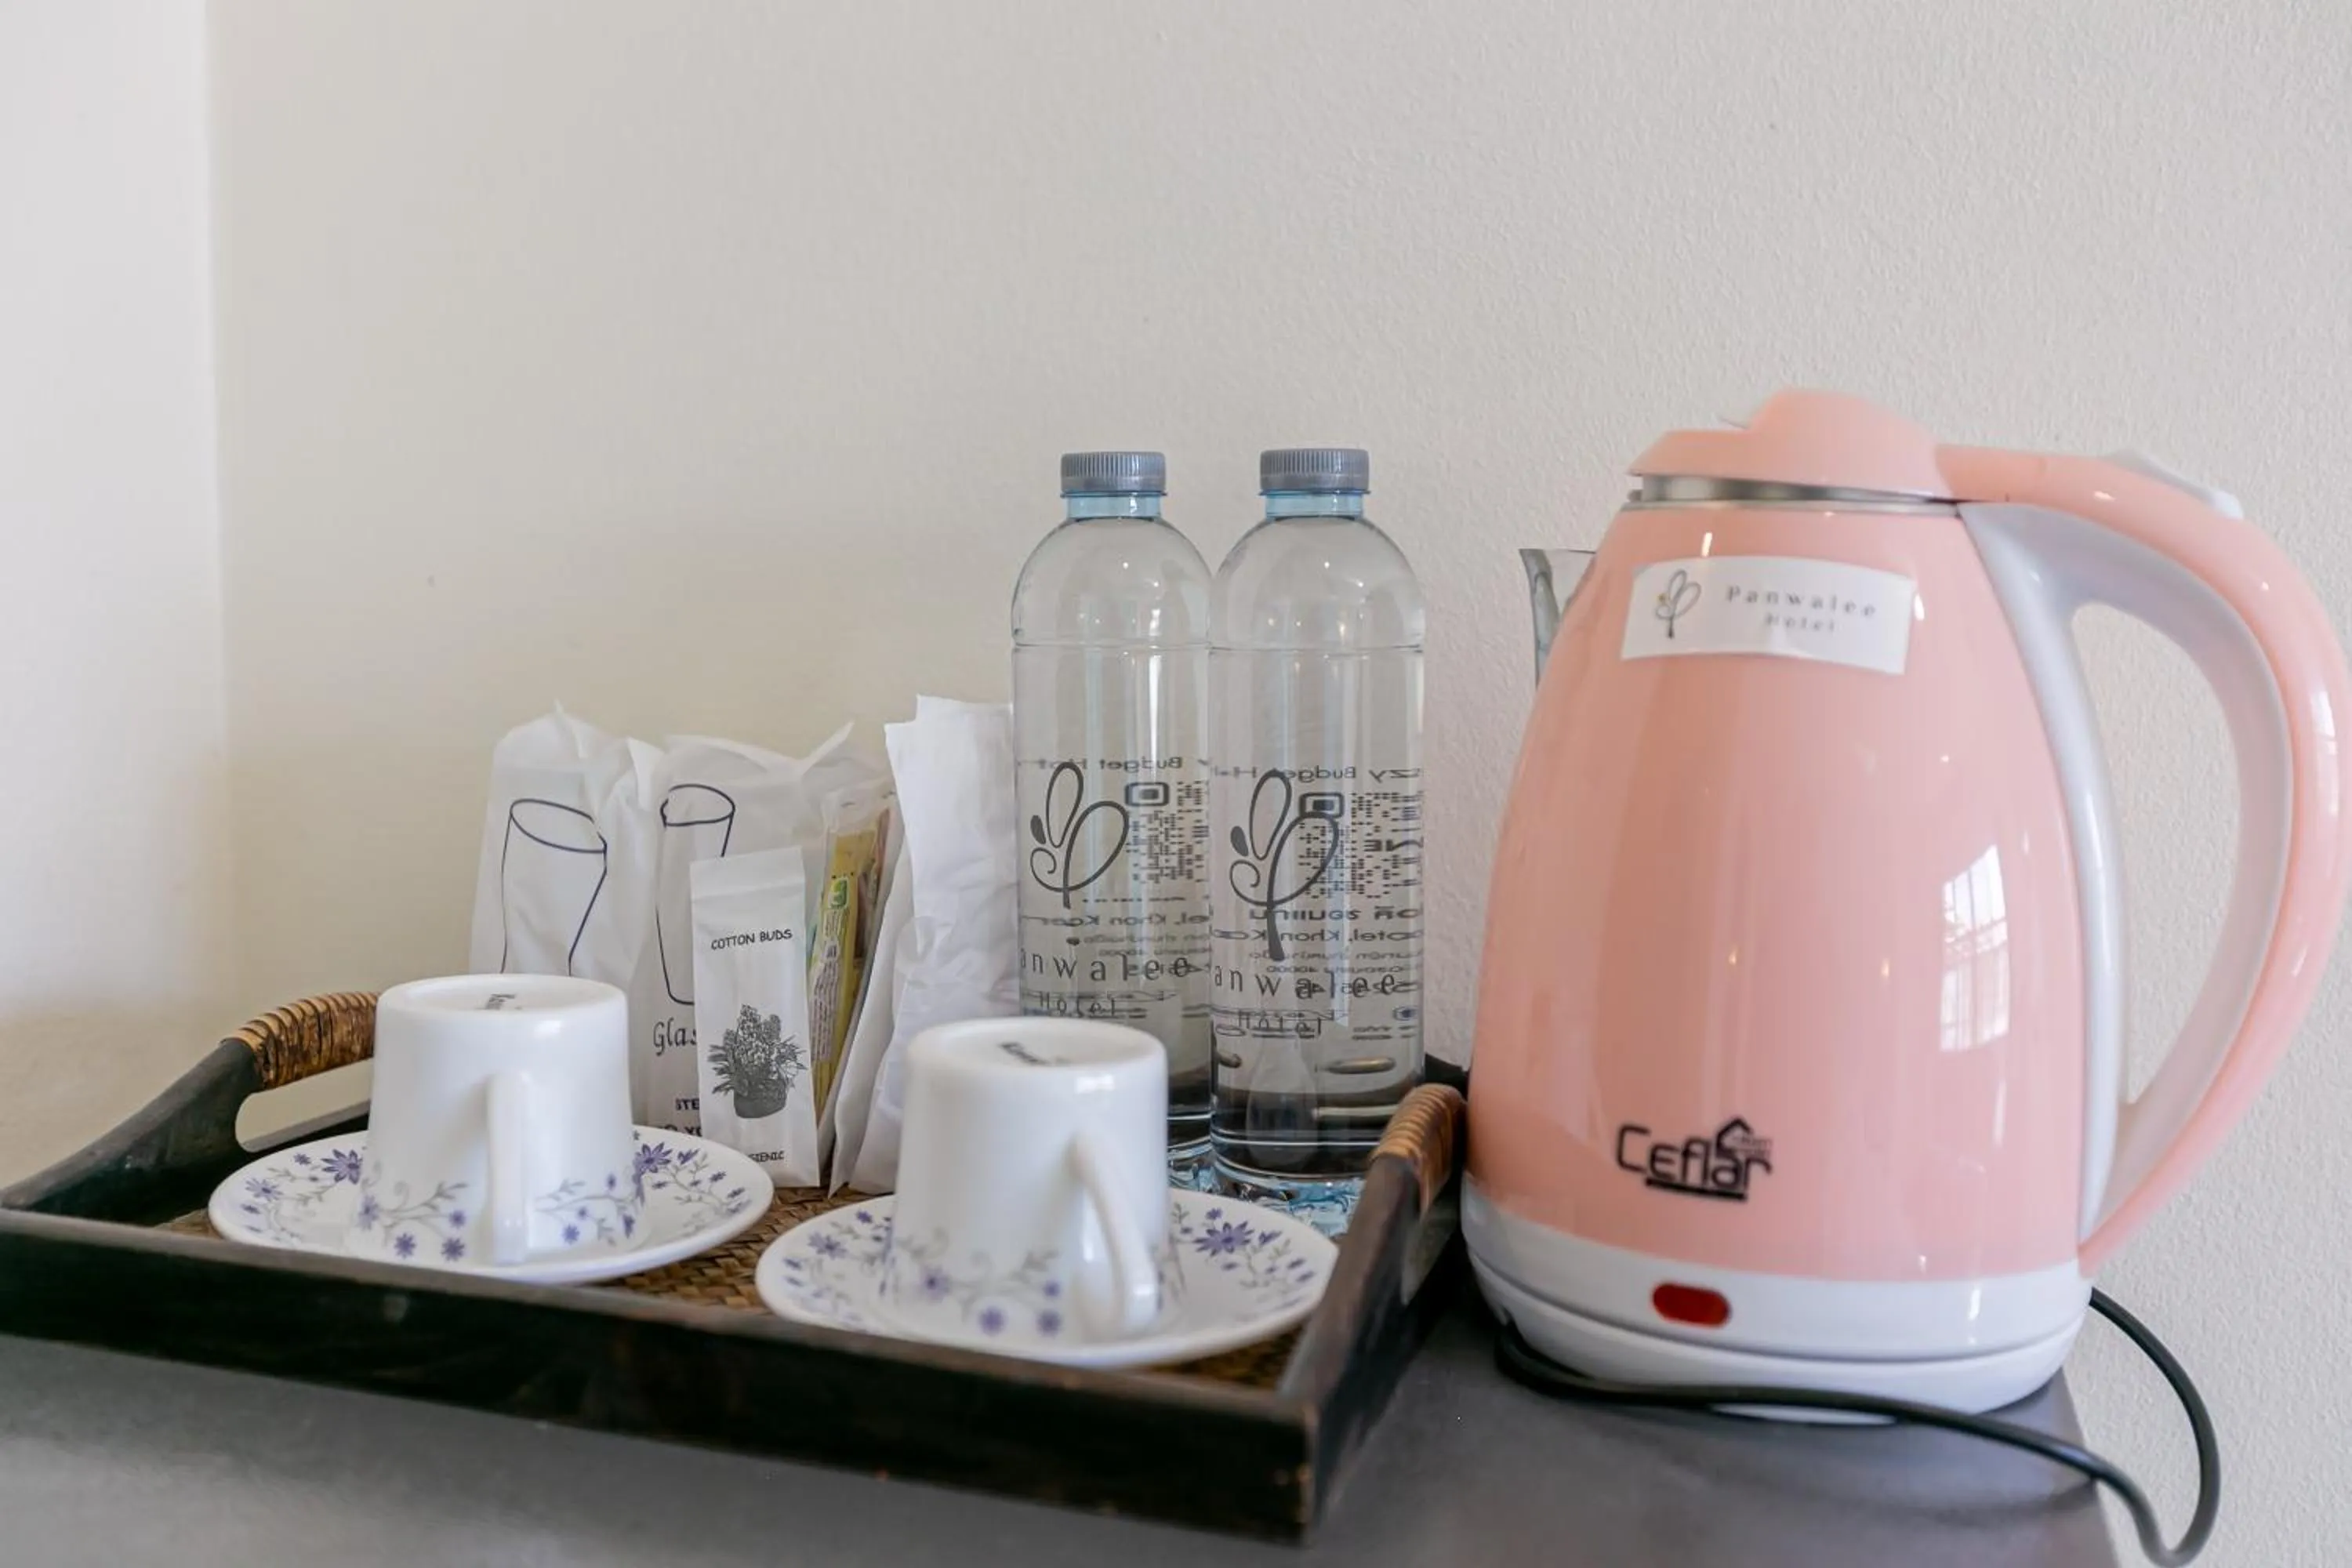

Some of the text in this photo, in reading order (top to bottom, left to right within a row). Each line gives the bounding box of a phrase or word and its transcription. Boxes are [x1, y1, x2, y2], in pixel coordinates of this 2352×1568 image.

[1727, 585, 1876, 616] Panwalee
[1765, 612, 1835, 631] Hotel
[711, 929, 793, 950] COTTON BUDS
